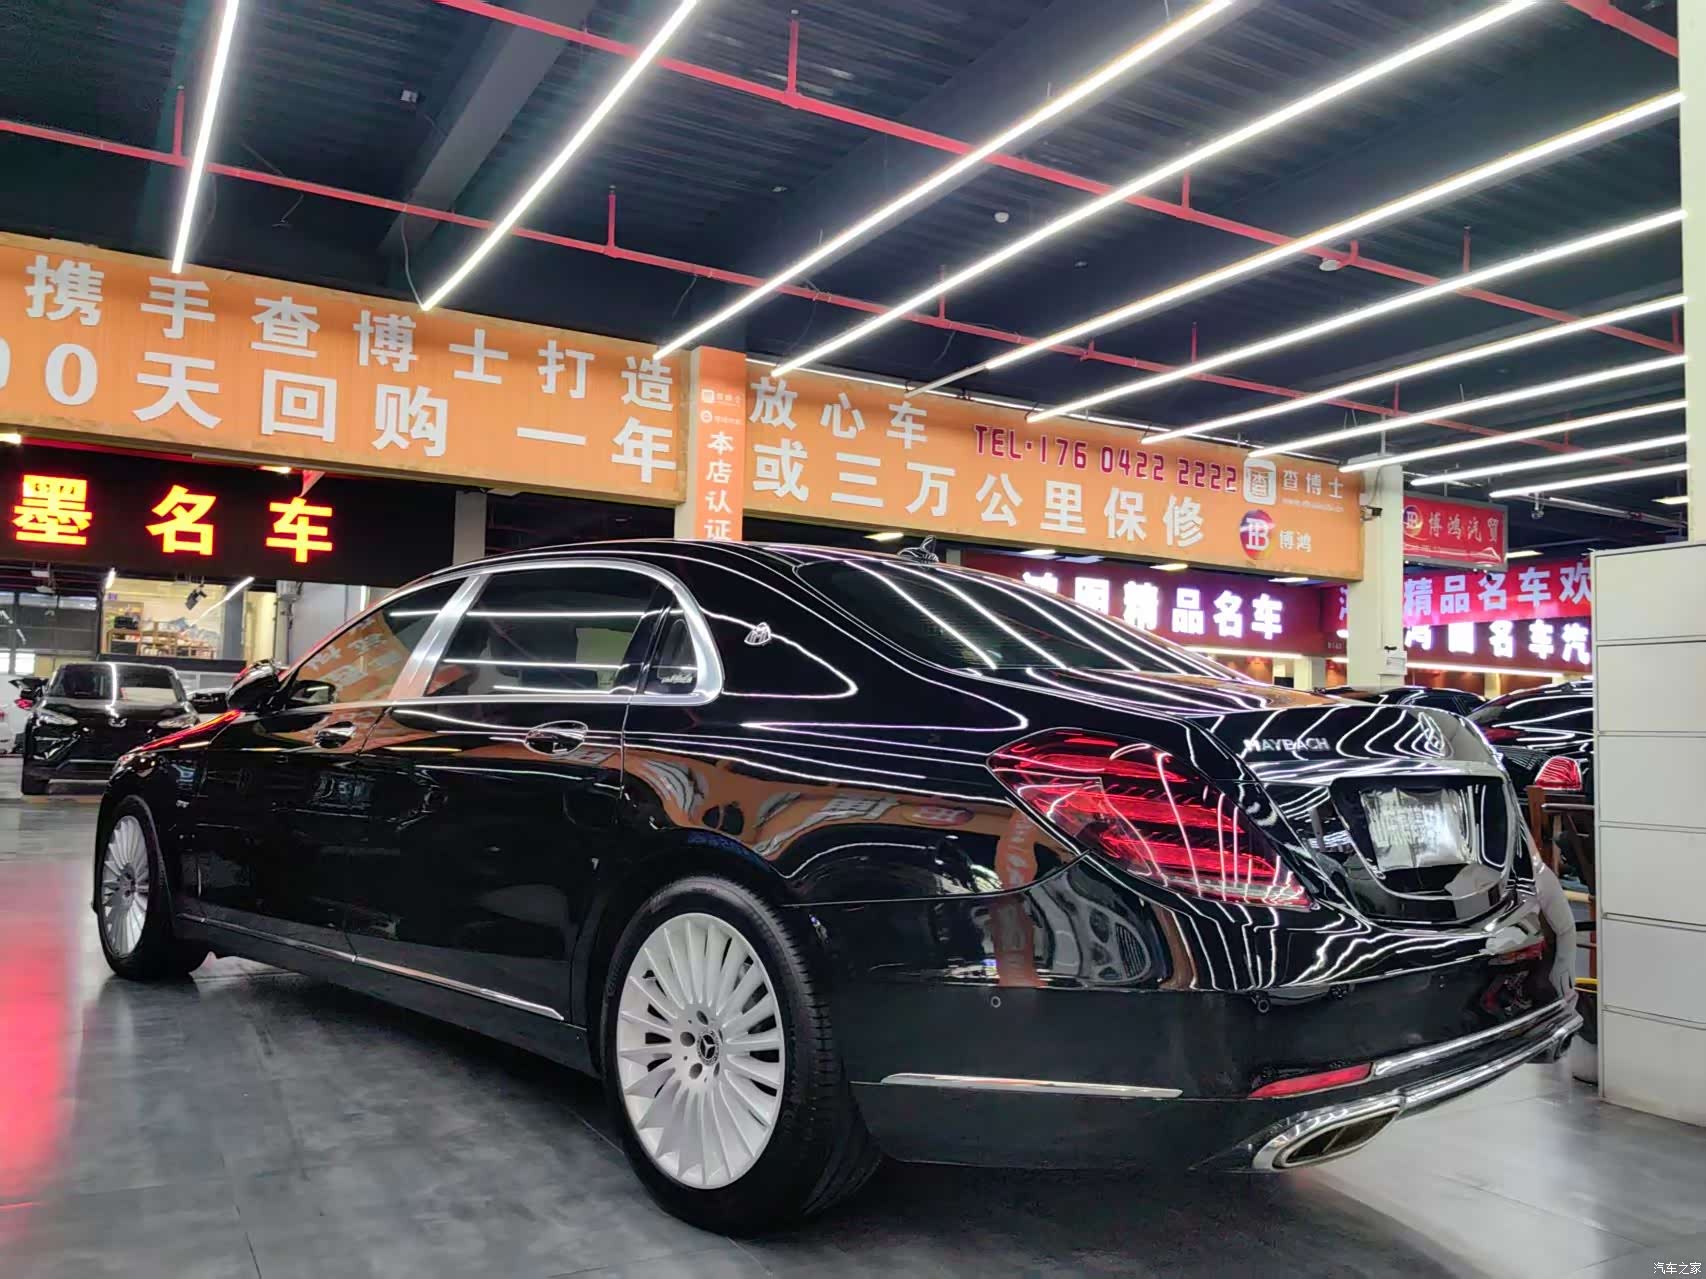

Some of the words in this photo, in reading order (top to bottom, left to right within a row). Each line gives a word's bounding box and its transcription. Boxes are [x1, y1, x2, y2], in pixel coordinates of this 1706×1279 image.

[25, 255, 674, 413] 携手查博士打造
[748, 377, 930, 450] 放心车
[704, 431, 735, 541] 本店认证
[752, 438, 1206, 548] 或三万公里保修
[1098, 445, 1166, 483] 0422
[1175, 456, 1239, 494] 2222
[1282, 469, 1344, 499] 查博士
[12, 474, 333, 564] 墨名车
[1242, 737, 1331, 753] MAYBACH
